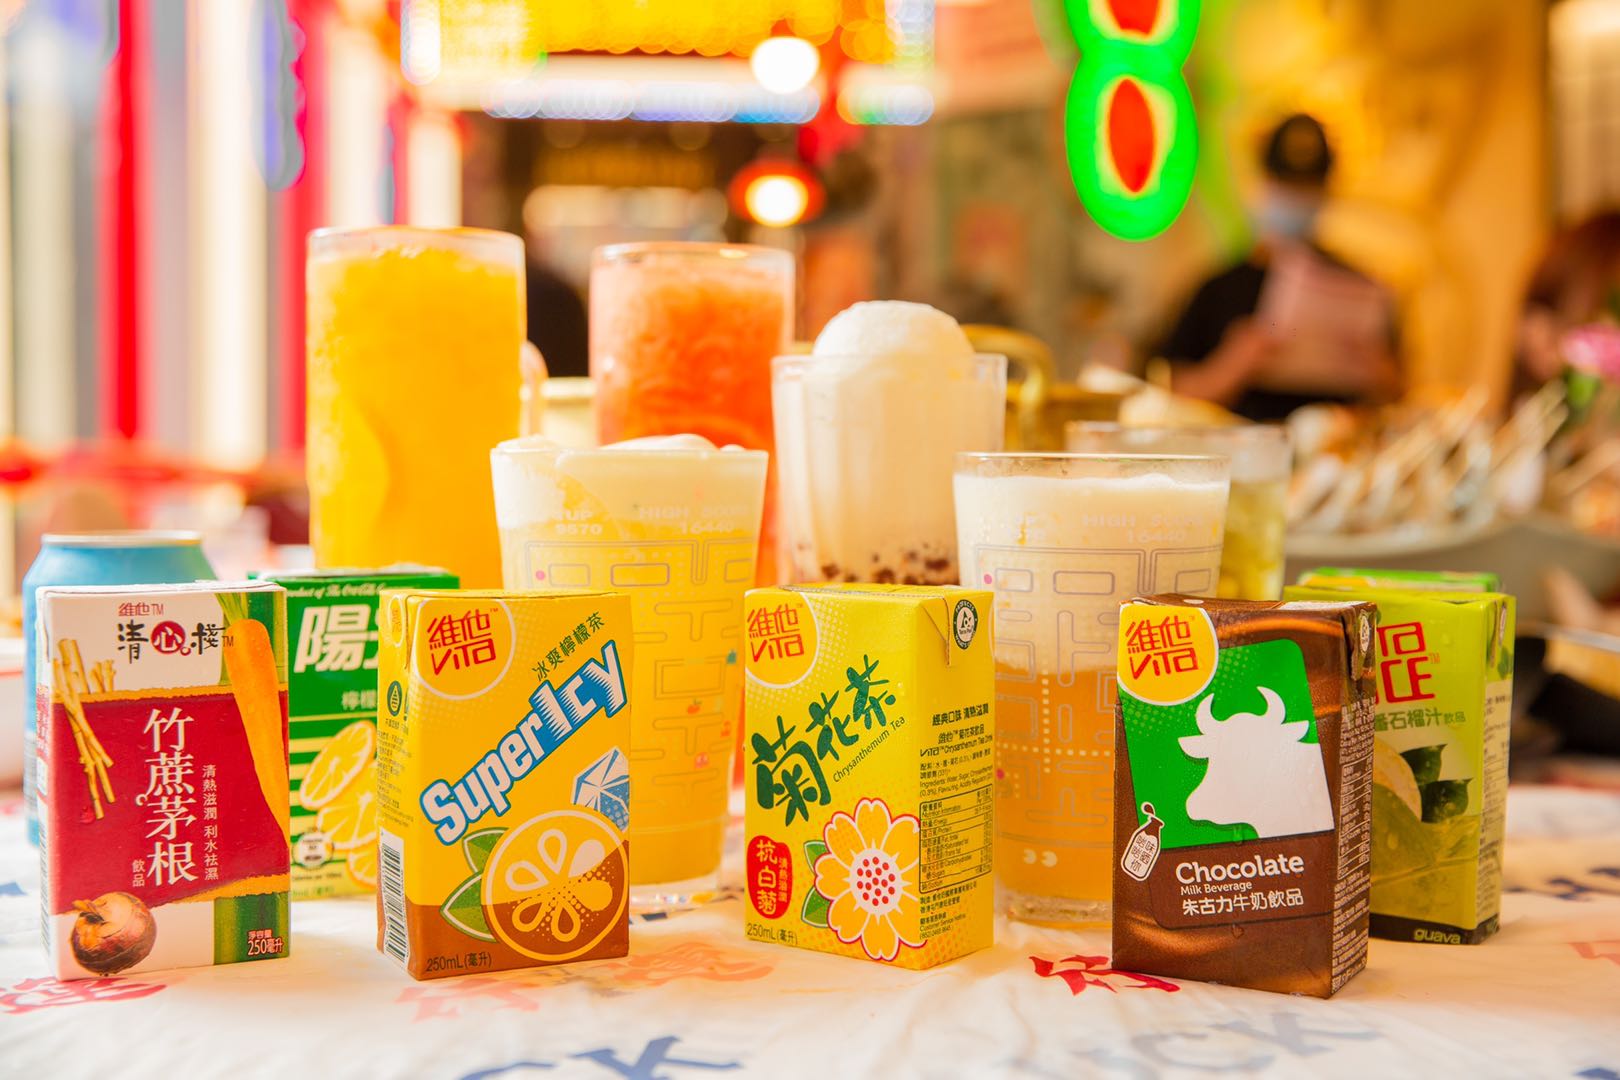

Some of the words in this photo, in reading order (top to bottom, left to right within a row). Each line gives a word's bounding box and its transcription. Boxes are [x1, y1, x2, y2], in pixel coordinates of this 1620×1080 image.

[293, 603, 379, 674] 陽
[751, 653, 897, 827] 菊花茶
[832, 727, 891, 784] Chrysanthemum
[890, 715, 906, 732] Tea
[143, 707, 199, 887] 竹蔗茅根
[132, 859, 146, 888] 飲品
[1175, 853, 1306, 885] Chocolate
[1180, 885, 1203, 897] Milk
[1204, 881, 1253, 895] Beverage
[1182, 887, 1305, 917] 朱古力牛奶飲品
[1414, 928, 1462, 945] guava
